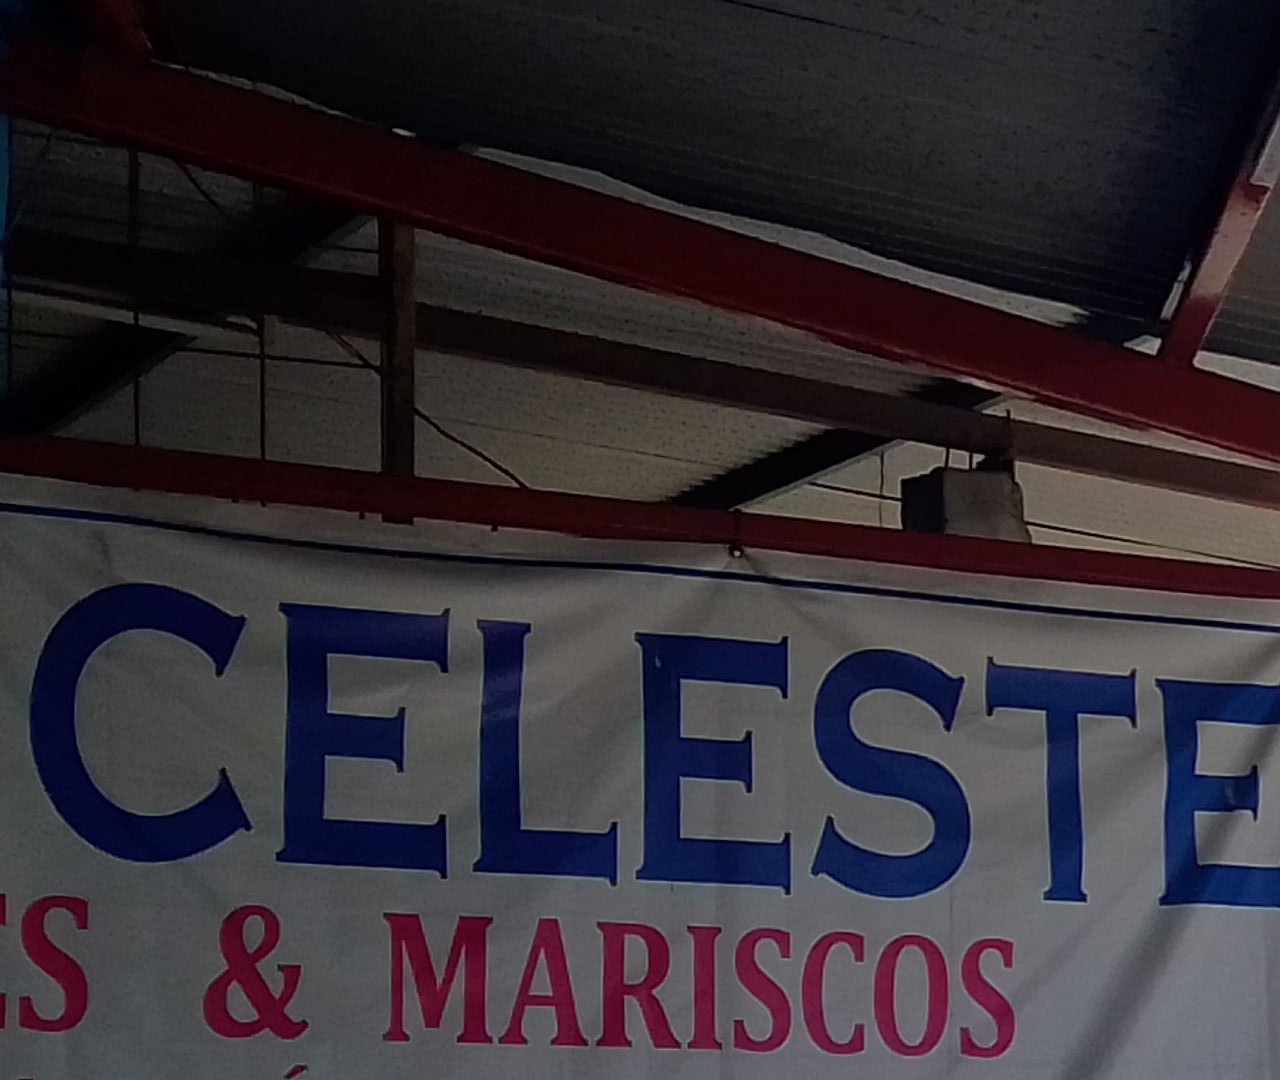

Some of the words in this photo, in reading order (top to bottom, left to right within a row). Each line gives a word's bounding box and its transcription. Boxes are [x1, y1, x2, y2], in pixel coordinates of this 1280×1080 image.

[0, 893, 88, 1032] S
[203, 904, 309, 1040] &
[382, 911, 1016, 1060] MARISCOS
